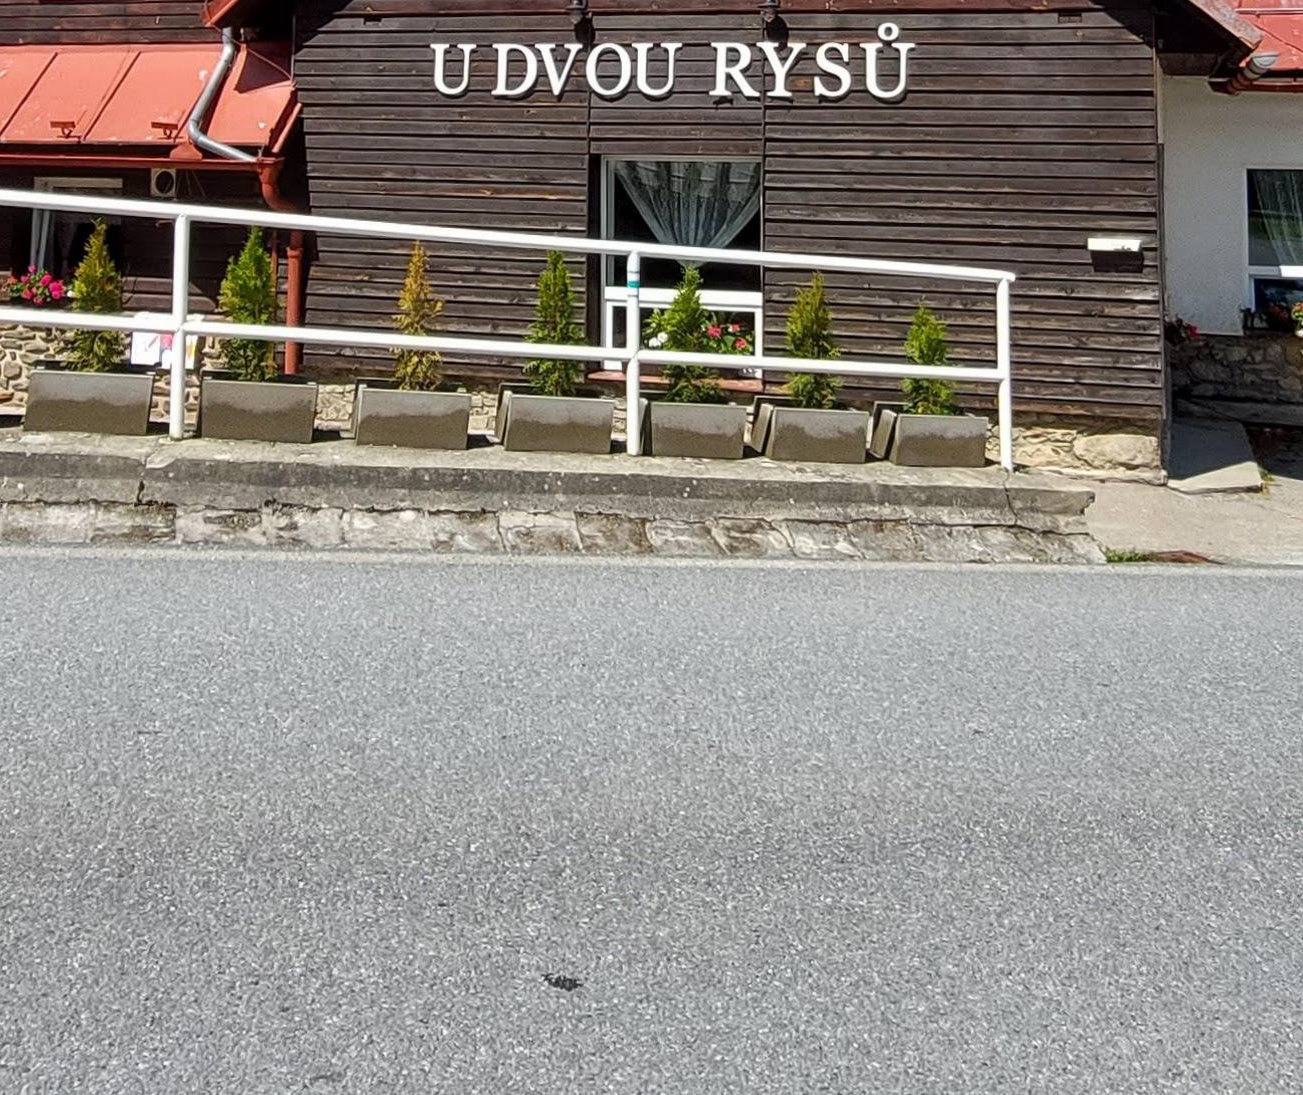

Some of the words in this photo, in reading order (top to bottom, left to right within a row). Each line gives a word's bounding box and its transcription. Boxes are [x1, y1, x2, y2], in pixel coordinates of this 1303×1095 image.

[430, 42, 477, 96] U
[491, 42, 683, 97] DVOU
[709, 22, 916, 98] RYSŮ
